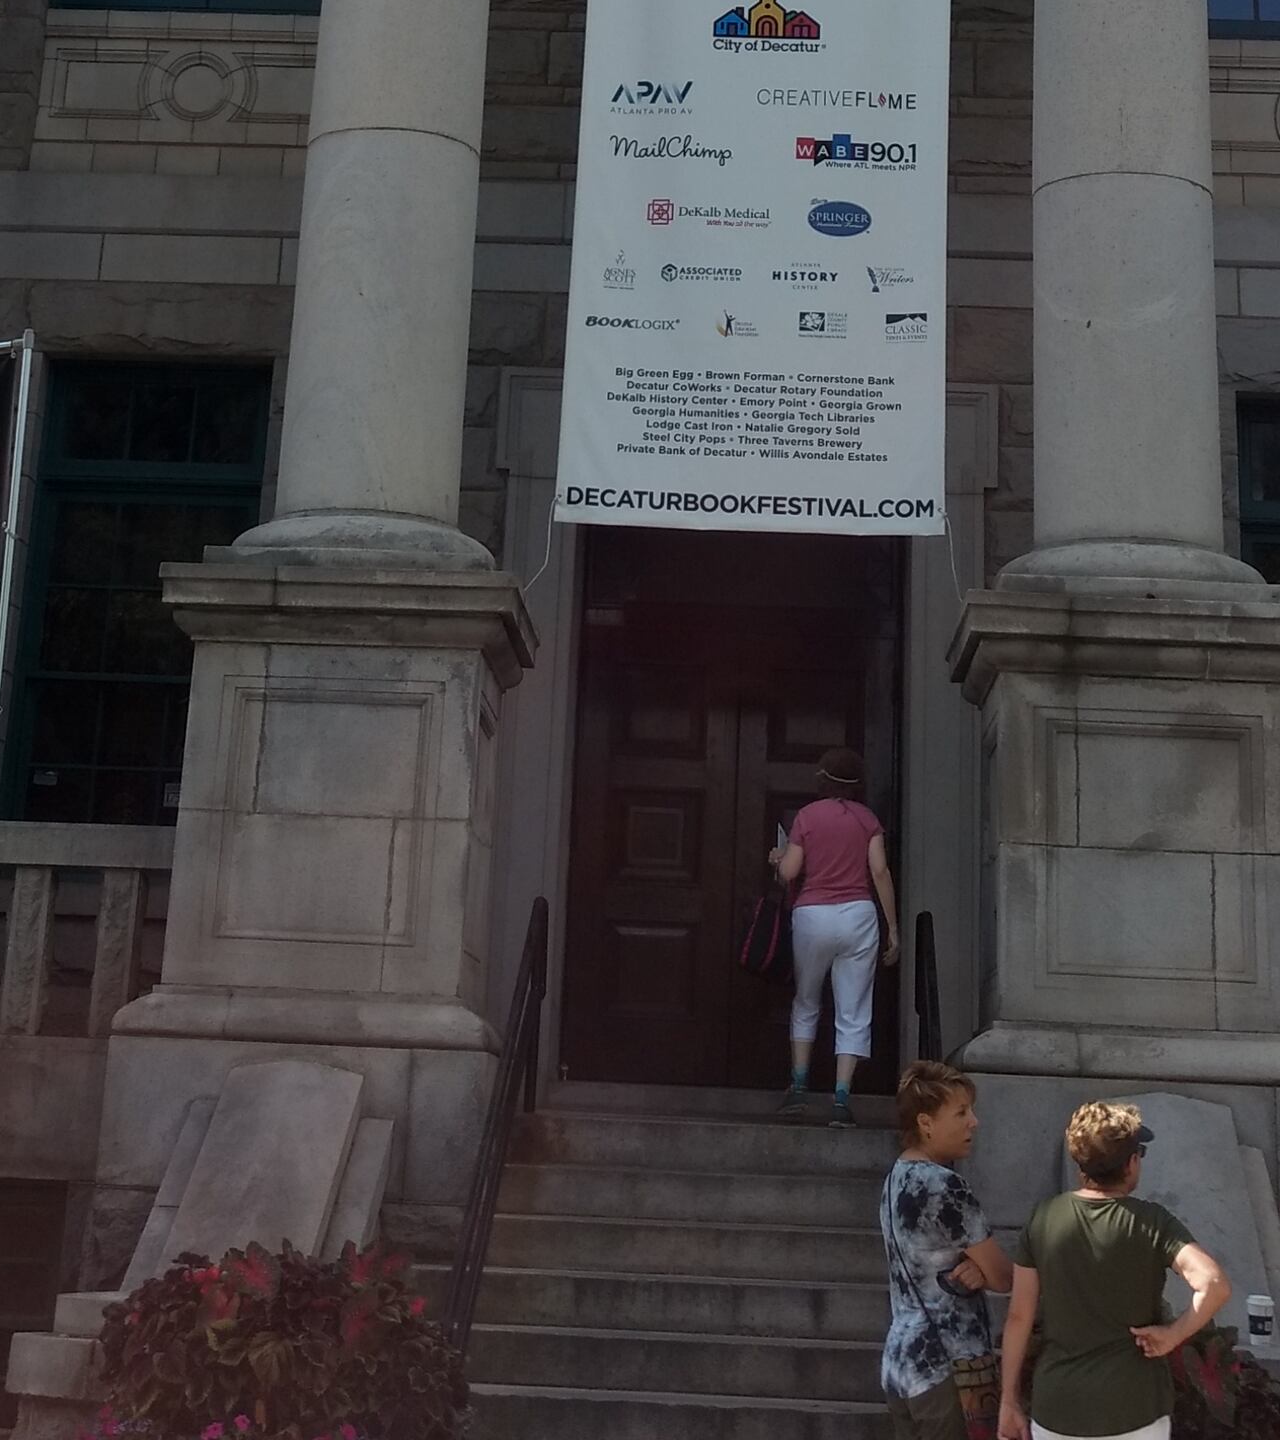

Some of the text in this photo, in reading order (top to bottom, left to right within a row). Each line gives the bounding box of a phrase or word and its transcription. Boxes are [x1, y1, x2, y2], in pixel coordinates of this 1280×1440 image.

[713, 39, 742, 53] City
[744, 39, 758, 52] of
[611, 80, 693, 105] APAV
[610, 107, 654, 115] ATLANTA
[610, 135, 733, 166] MailChimp
[826, 161, 851, 169] Where
[854, 162, 869, 170] ATL
[678, 206, 770, 219] DeKalb Medical
[810, 211, 869, 225] SPRINGER
[680, 267, 742, 277] ASSOCIATED
[772, 271, 838, 282] HISTORY
[885, 325, 927, 334] CLASSIC
[615, 368, 895, 385] Big Green Egg Brown Forman Cornerstone Bank
[627, 380, 883, 398] Decatur CoWorks Decatur Rotary Foundation
[607, 392, 902, 412] DeKalb History Center Emory Point Georgia Grown
[632, 406, 875, 423] Georgia Humanities Georgia Tech Libraries
[646, 419, 860, 437] Lodge Cast Iron Natalie Gregory Sold
[642, 432, 862, 450] Steel City Pops Three Taverns Brewery
[617, 443, 888, 462] Private Bank of Decatur Willis Avondale Estates
[567, 486, 934, 518] DECATURBOOKFESTIVAL.COM
